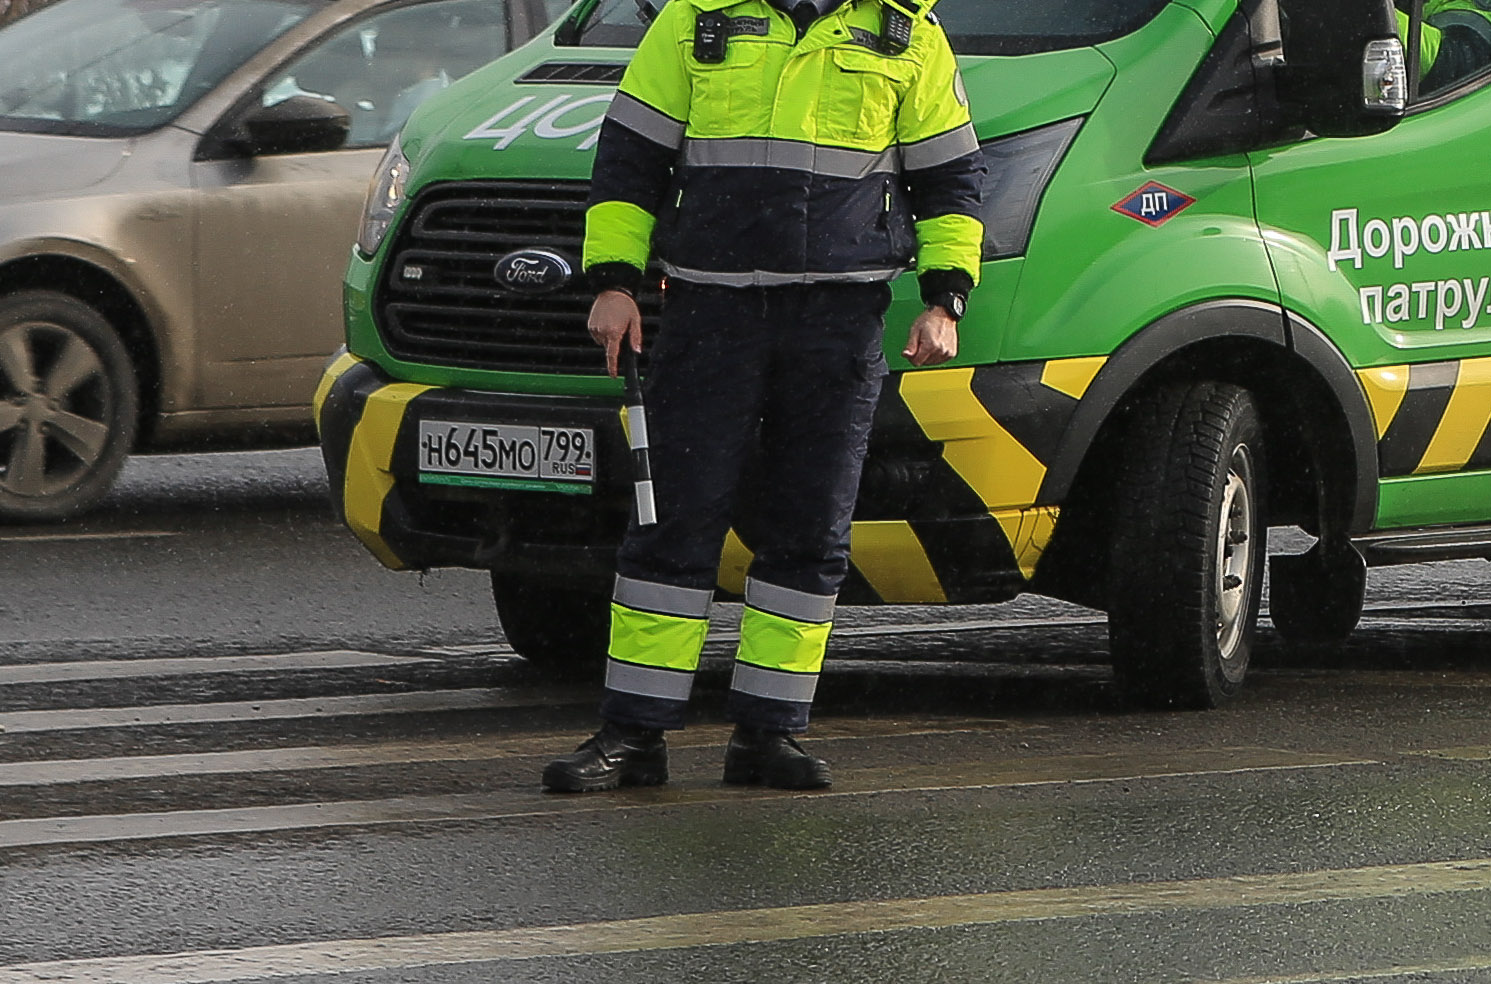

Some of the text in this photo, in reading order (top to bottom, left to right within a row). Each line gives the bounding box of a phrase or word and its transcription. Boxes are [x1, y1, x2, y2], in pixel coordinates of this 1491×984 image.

[1141, 192, 1168, 216] ДП
[506, 257, 549, 283] Ford
[541, 429, 587, 462] 799
[552, 462, 576, 474] RUS
